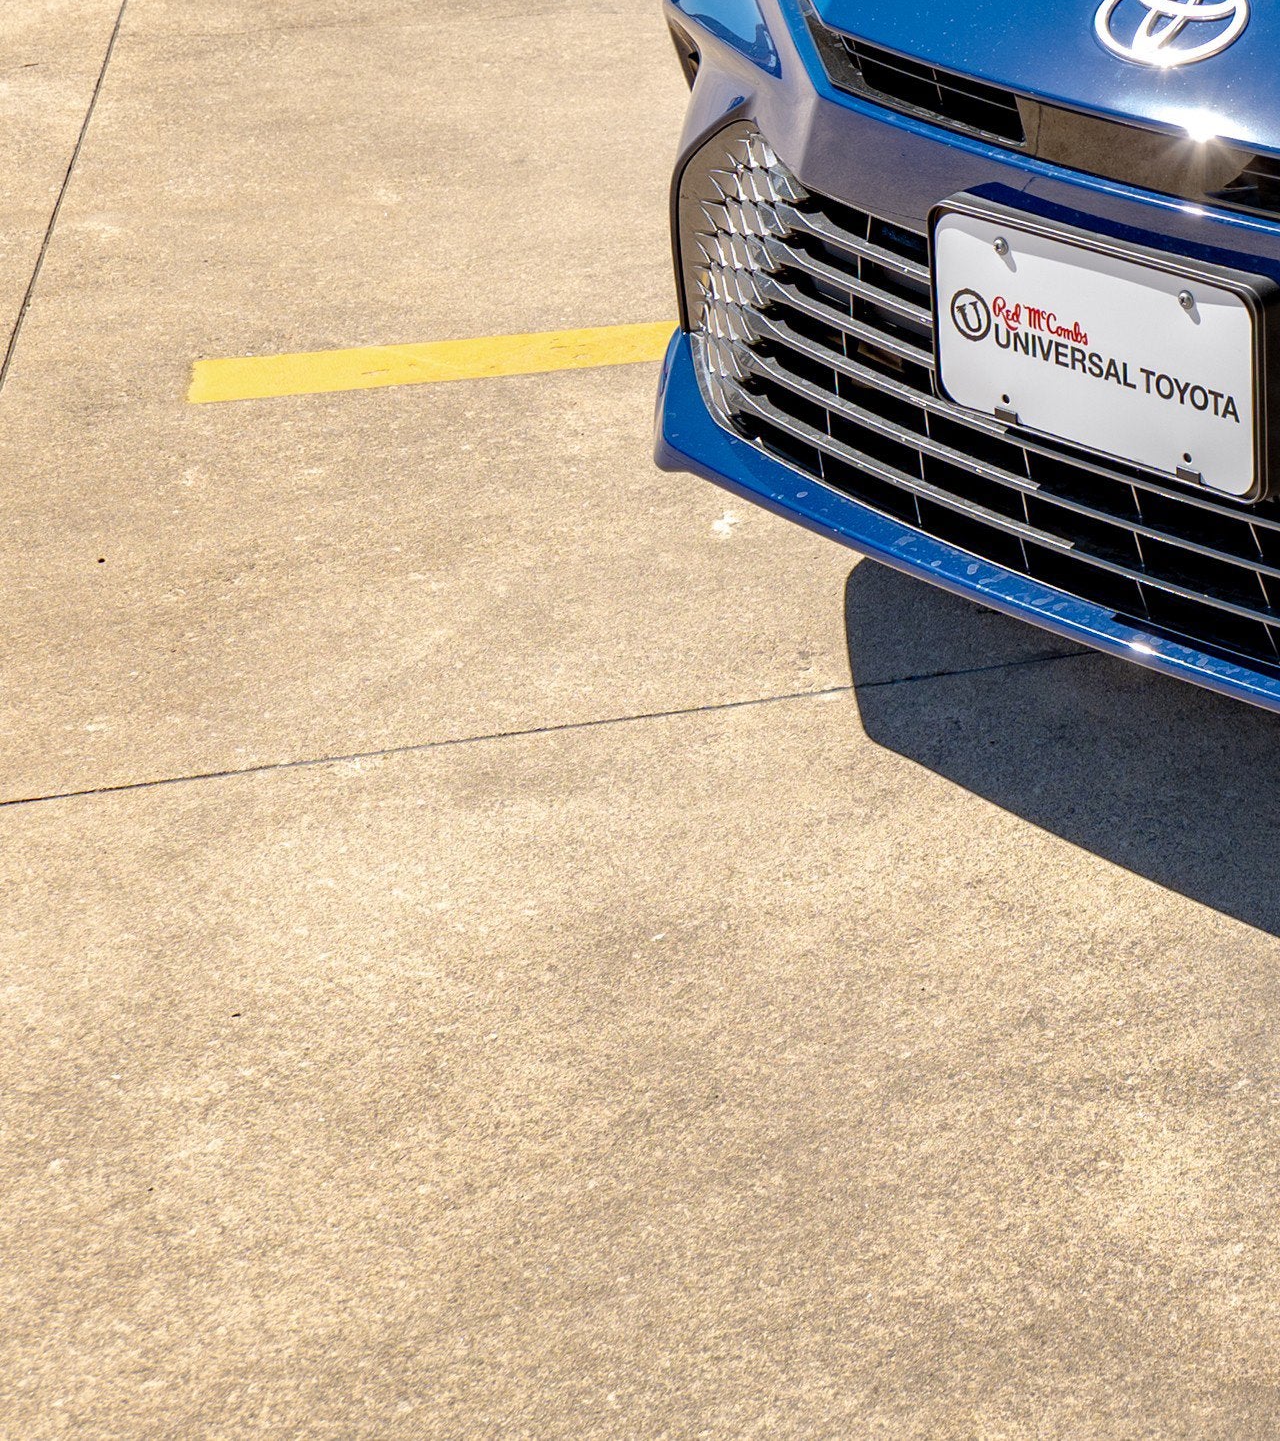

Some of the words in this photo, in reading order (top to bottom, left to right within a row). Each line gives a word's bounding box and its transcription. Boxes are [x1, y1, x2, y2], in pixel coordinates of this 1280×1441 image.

[992, 296, 1022, 331] Red
[1023, 304, 1088, 346] McCombs
[994, 323, 1137, 390] UNIVERSAL
[1140, 367, 1241, 424] TOYOTA
